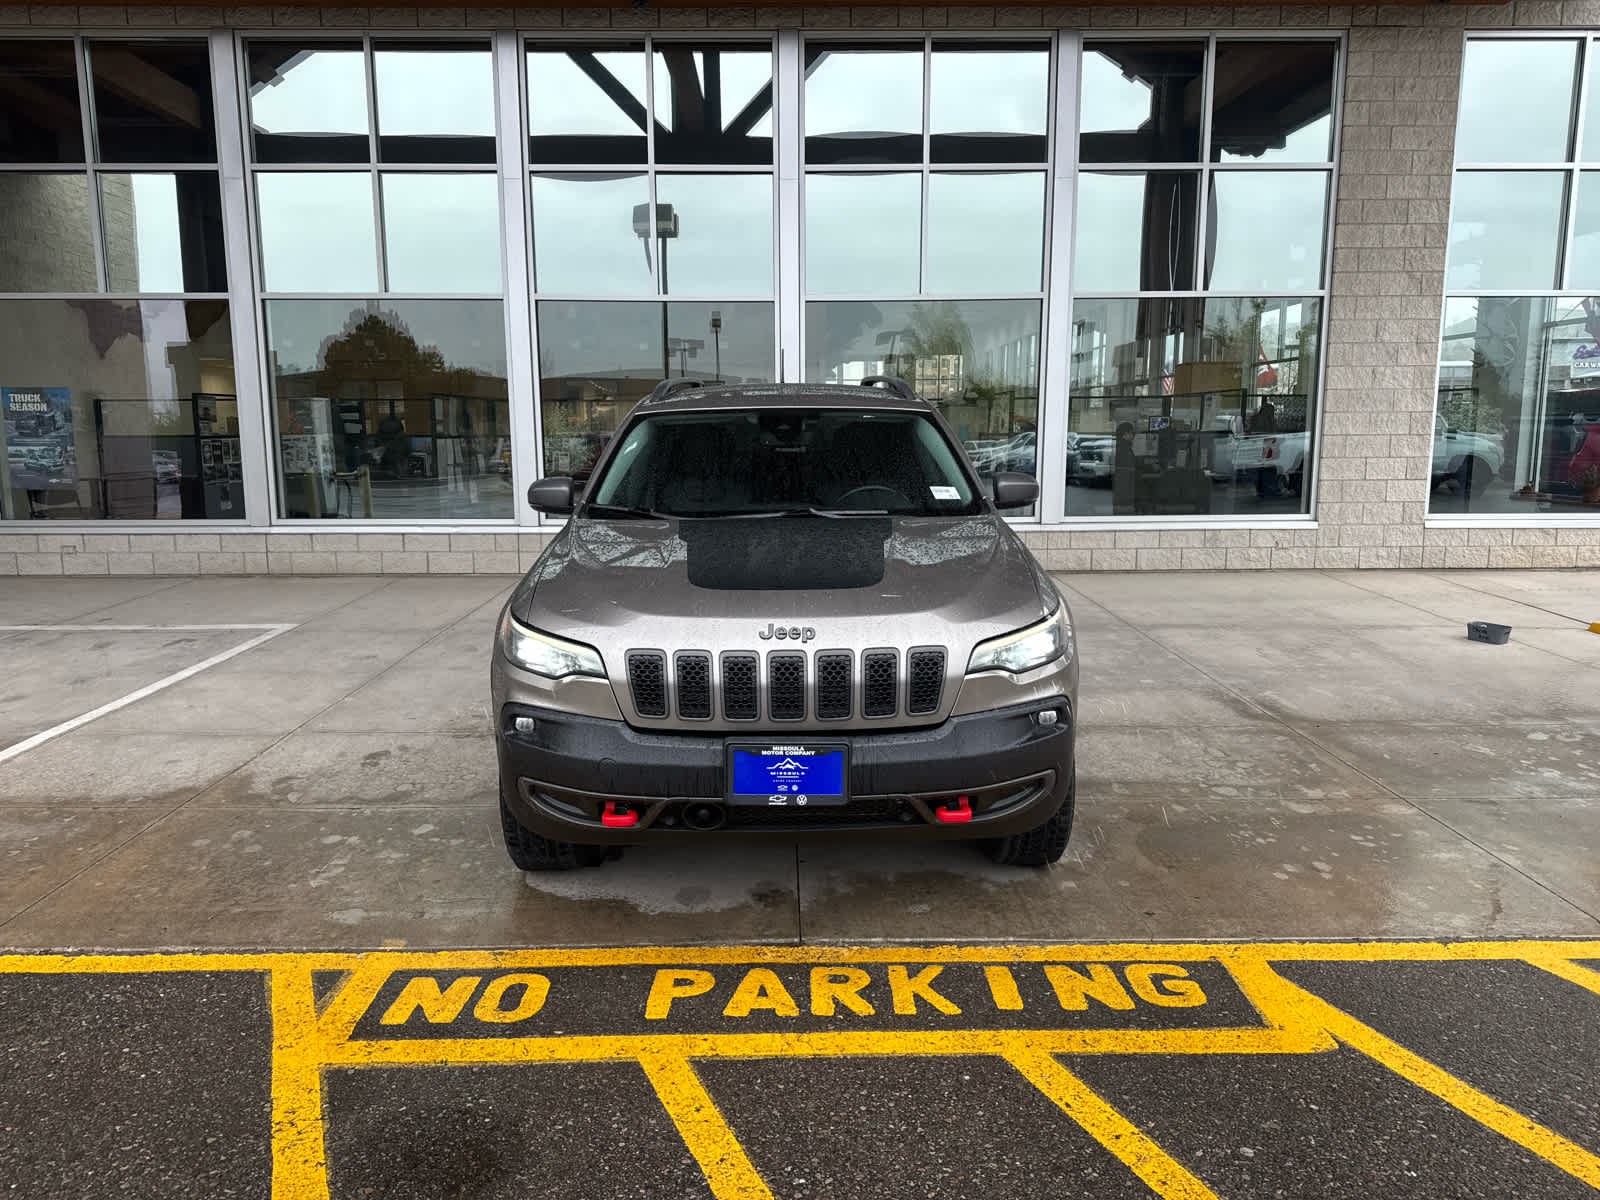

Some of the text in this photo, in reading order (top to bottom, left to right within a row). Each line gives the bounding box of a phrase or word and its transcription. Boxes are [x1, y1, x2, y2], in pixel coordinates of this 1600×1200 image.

[8, 393, 40, 402] TRUCK
[10, 403, 47, 412] SEASON
[759, 623, 816, 643] Jeep
[380, 963, 1207, 1024] NO PARKING
